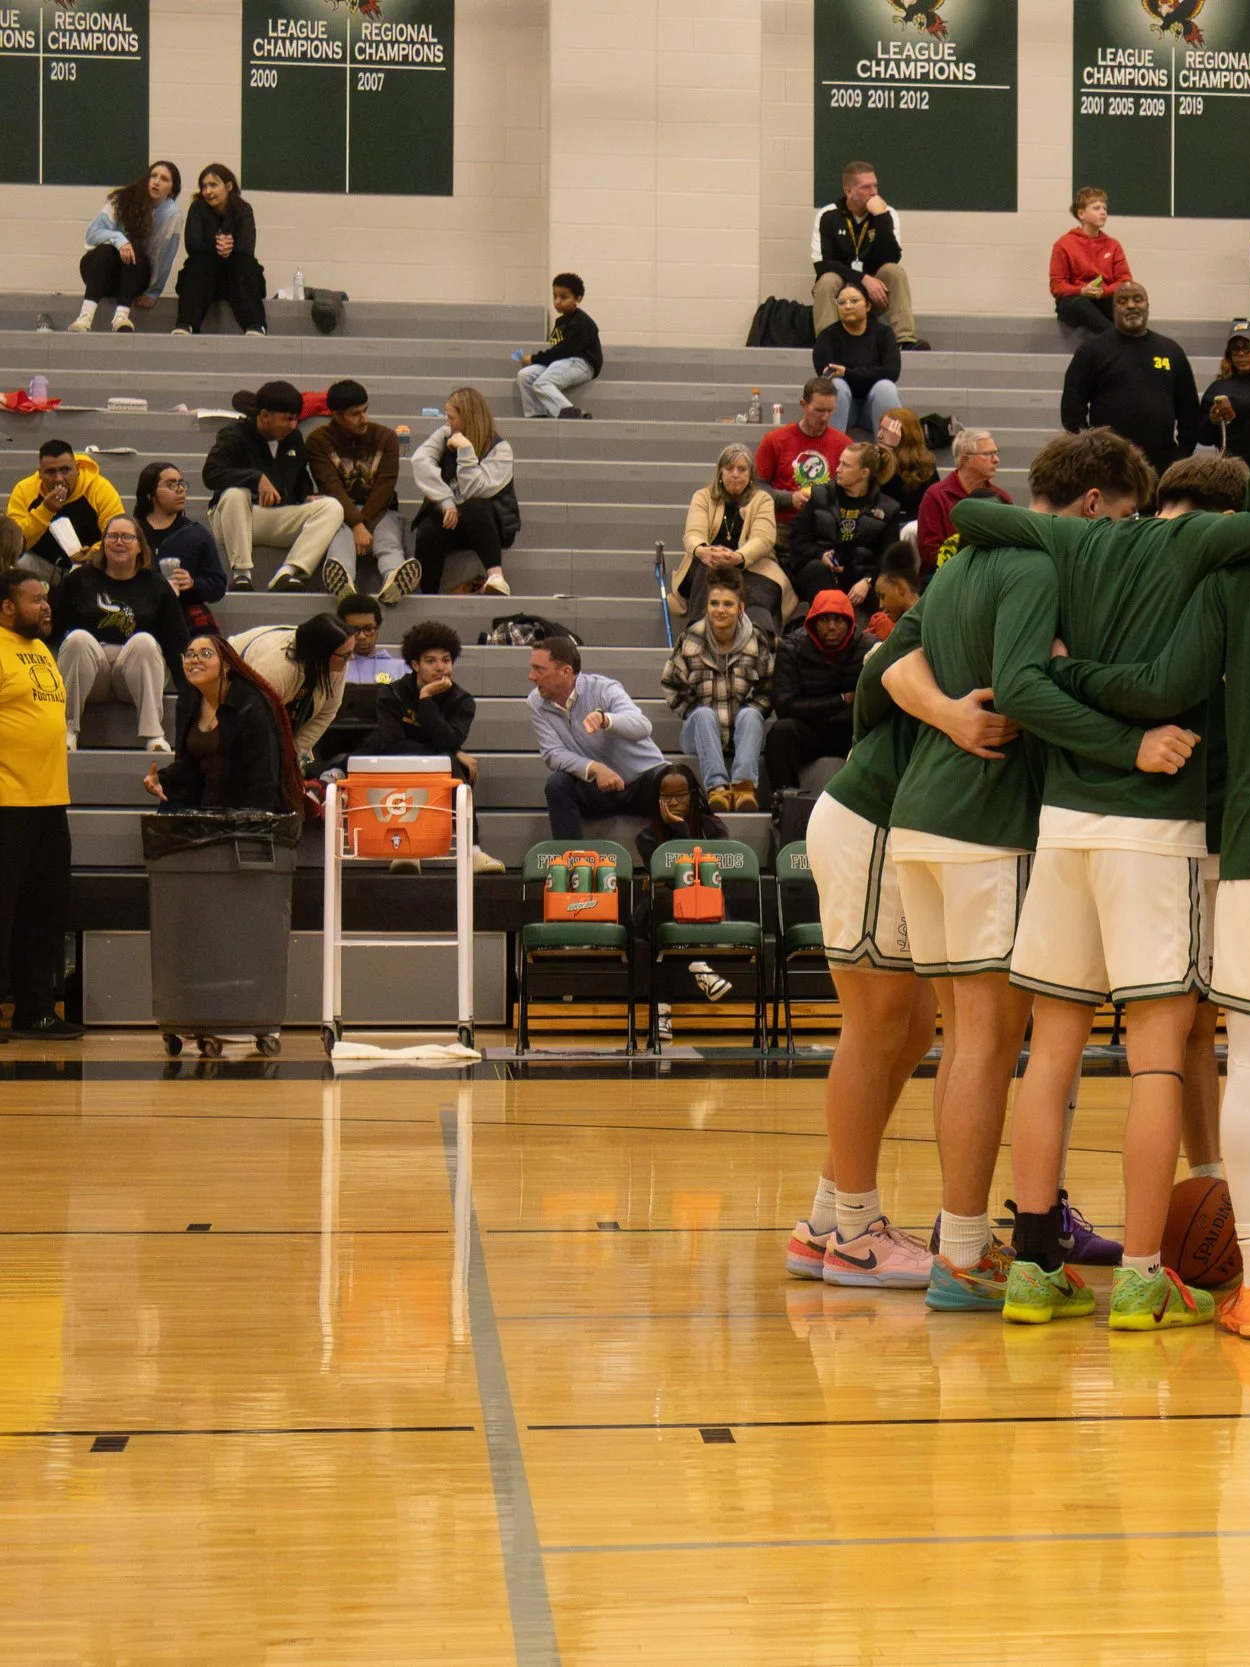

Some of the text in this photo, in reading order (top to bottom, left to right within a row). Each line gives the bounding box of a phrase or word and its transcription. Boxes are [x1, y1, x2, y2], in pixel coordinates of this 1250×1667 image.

[54, 11, 133, 32] REGIONAL
[268, 19, 328, 39] LEAGUE
[47, 31, 139, 52] CHAMPIONS
[361, 22, 438, 43] REGIONAL
[252, 38, 343, 60] CHAMPIONS
[354, 42, 444, 63] CHAMPIONS
[876, 40, 957, 61] LEAGUE
[1097, 47, 1154, 67] LEAGUE
[50, 62, 77, 81] 2013
[250, 68, 278, 89] 2000
[856, 59, 976, 81] CHAMPIONS
[1082, 66, 1168, 87] CHAMPIONS
[357, 72, 384, 91] 2007
[830, 88, 929, 110] 2009 2011 2012
[1080, 96, 1165, 117] 2001 2005 2009
[1178, 96, 1204, 115] 2019
[1152, 356, 1171, 371] 34
[32, 687, 65, 704] FOOTBALL
[385, 791, 407, 816] G
[1192, 1193, 1232, 1264] SPALDING
